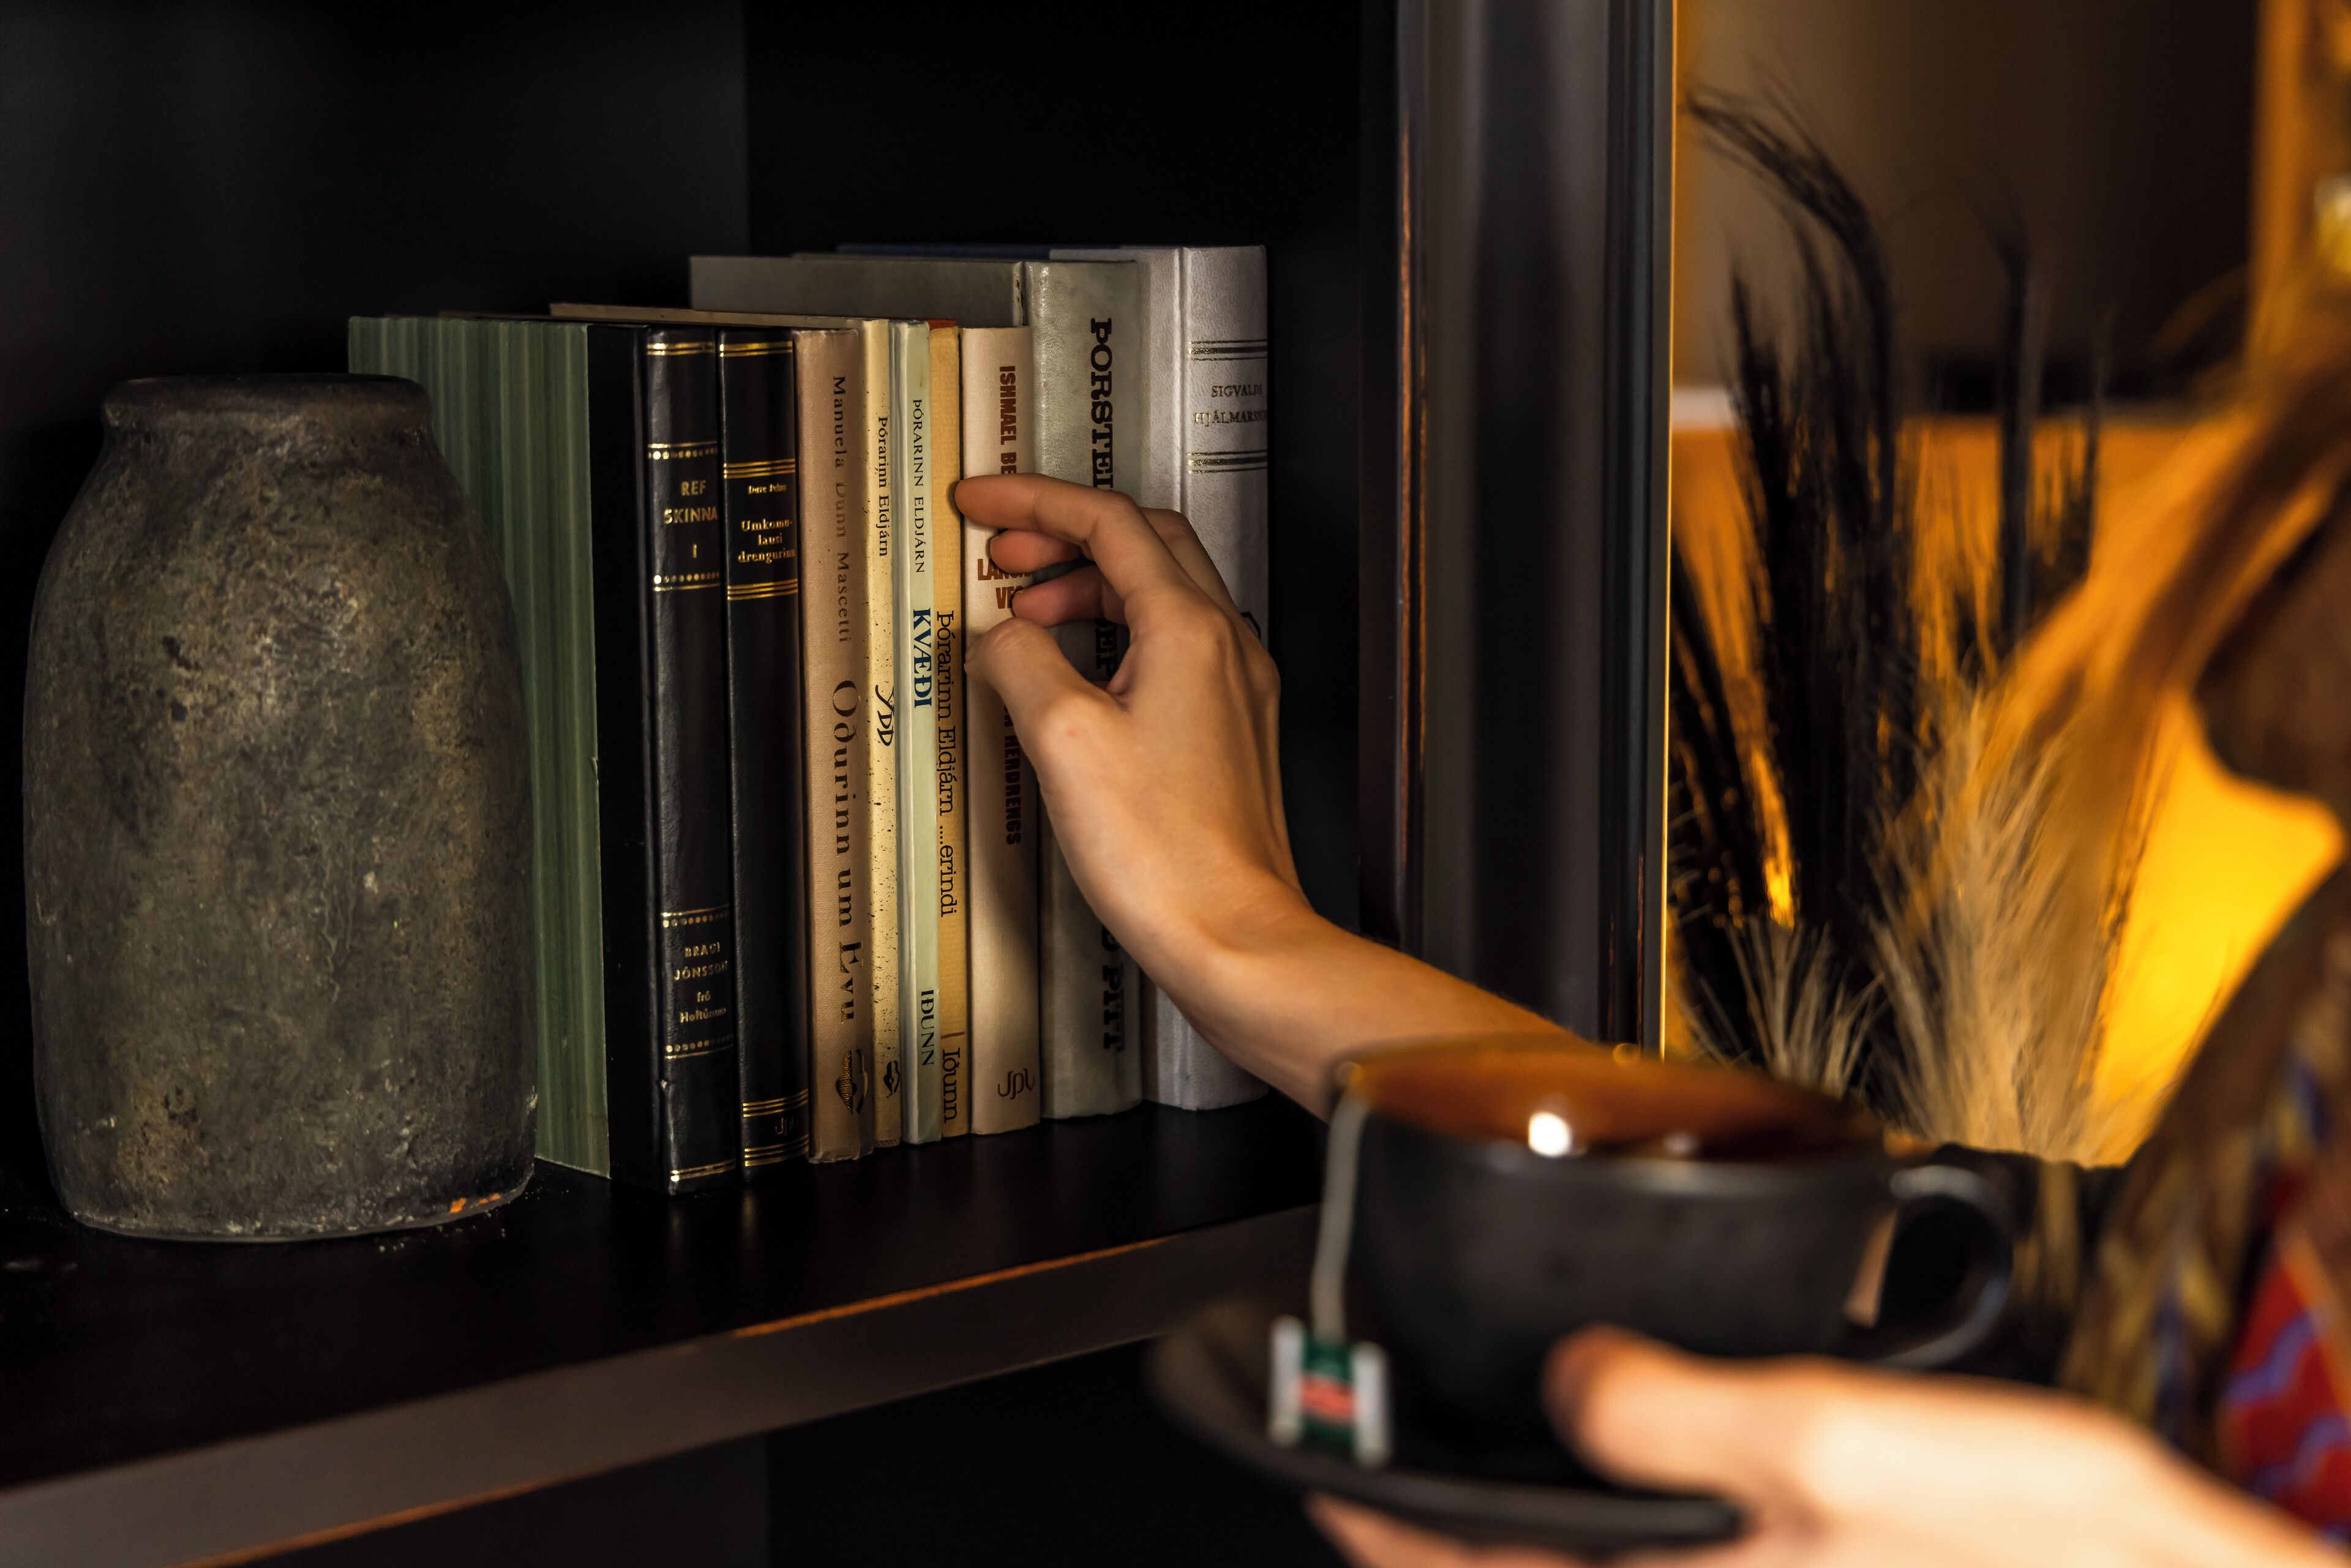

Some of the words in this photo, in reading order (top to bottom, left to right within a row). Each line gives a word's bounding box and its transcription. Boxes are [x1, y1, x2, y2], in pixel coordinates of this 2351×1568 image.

[833, 376, 848, 468] Manuela
[1000, 366, 1017, 446] ISHMAEL
[1091, 318, 1114, 490] ÞORSTEI
[1211, 384, 1262, 397] SIGVALDI
[878, 416, 889, 489] Þórarinn
[913, 399, 924, 487] ÞÓRARINN
[1001, 452, 1017, 475] BE
[664, 506, 718, 525] SKINNA
[681, 480, 706, 496] REF
[748, 485, 767, 495] Dave
[835, 482, 848, 538] Dunn
[737, 547, 796, 564] drengurinn
[757, 533, 783, 546] lausi
[876, 495, 890, 557] Eldjárn
[914, 497, 926, 573] ELDJÁRN
[837, 552, 852, 642] Mascetti
[913, 607, 932, 709] KVÆÐI
[937, 610, 956, 722] Þórarinn
[936, 725, 958, 817] Eldjárn
[1004, 735, 1022, 846] HERDRENGS
[838, 867, 852, 930] um
[673, 960, 727, 981] JÓNSSON
[684, 942, 720, 958] BRAGI
[839, 941, 864, 1024] Evu
[921, 989, 934, 1066] IÐUNN
[942, 1047, 961, 1124] Iðunn
